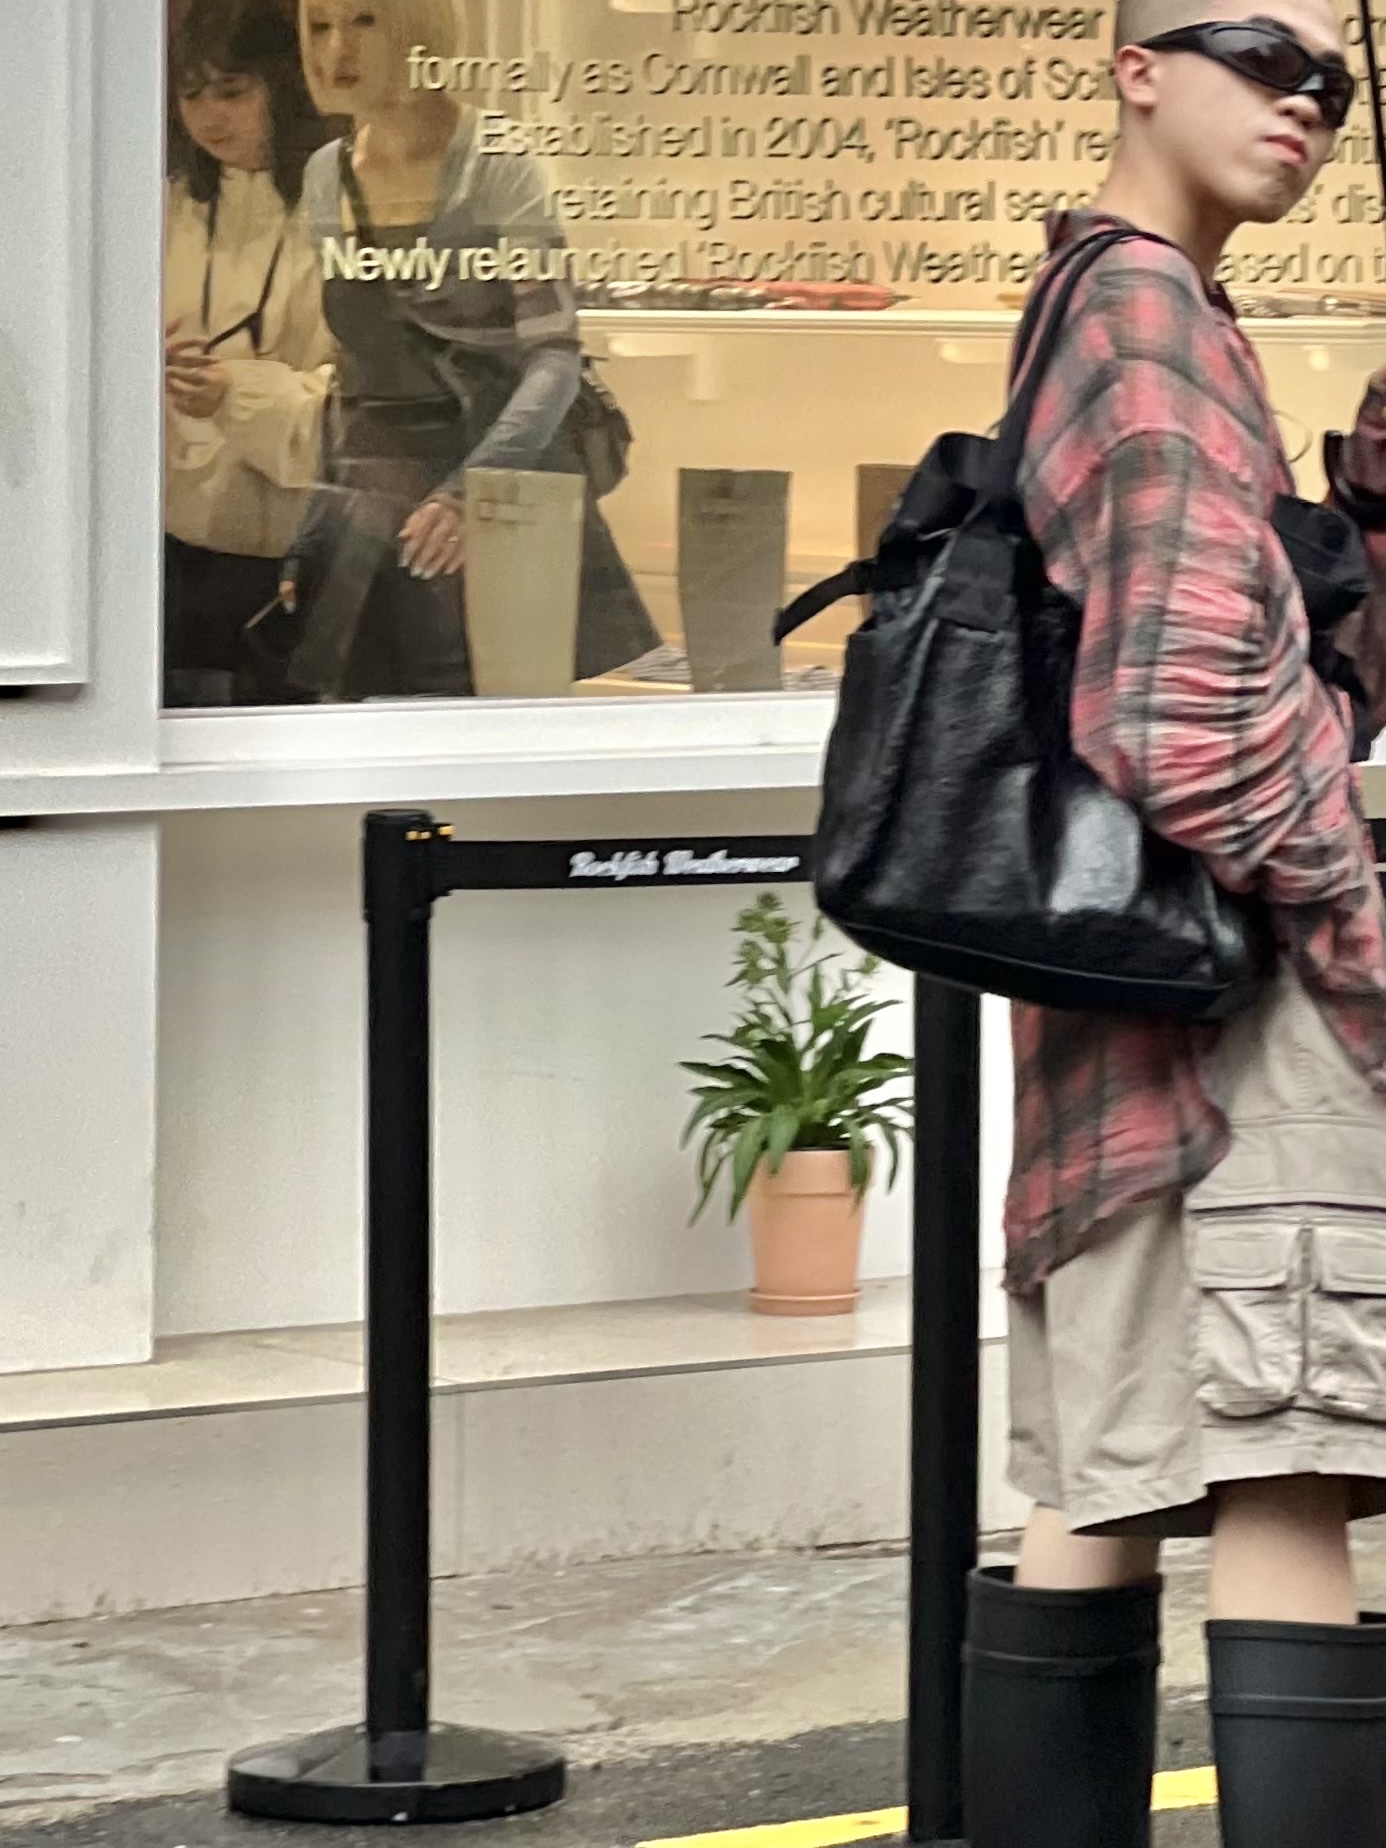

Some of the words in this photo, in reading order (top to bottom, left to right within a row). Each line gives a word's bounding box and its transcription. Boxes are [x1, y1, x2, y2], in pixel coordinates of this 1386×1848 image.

[407, 45, 574, 103] formally
[583, 59, 633, 94] as
[643, 52, 812, 96] Cornwall
[820, 56, 895, 98] and
[903, 56, 991, 100] Isles
[998, 56, 1037, 100] of
[479, 109, 711, 158] Established
[720, 115, 757, 158] in
[764, 115, 877, 164] 2004,
[545, 177, 718, 231] retaining
[729, 179, 849, 222] British
[858, 180, 996, 222] cultural
[322, 236, 451, 291] Newly
[459, 236, 687, 281] relaunched
[1317, 253, 1364, 284] on
